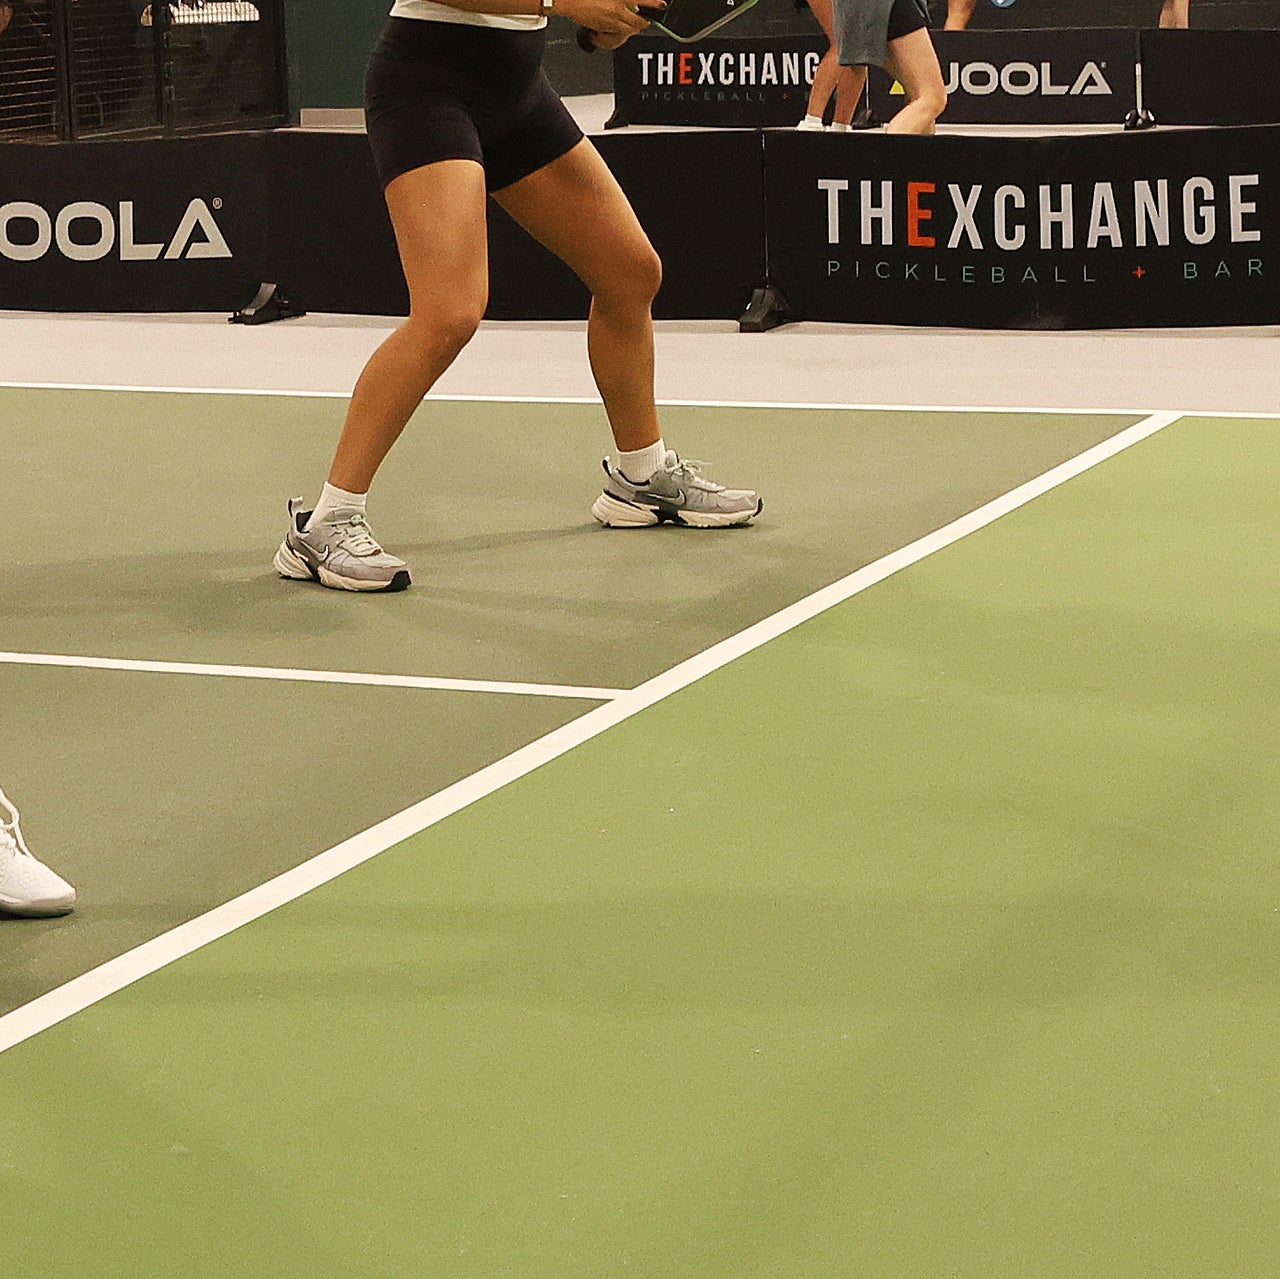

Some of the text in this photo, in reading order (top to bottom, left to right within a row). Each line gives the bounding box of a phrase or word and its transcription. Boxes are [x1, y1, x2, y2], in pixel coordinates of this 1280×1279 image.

[637, 52, 819, 86] THEXCHANG
[640, 91, 767, 102] PICKLEBALL
[817, 174, 1262, 251] THEXCHANGE
[827, 260, 1096, 284] PICKLEBALL
[1183, 259, 1264, 280] BAR
